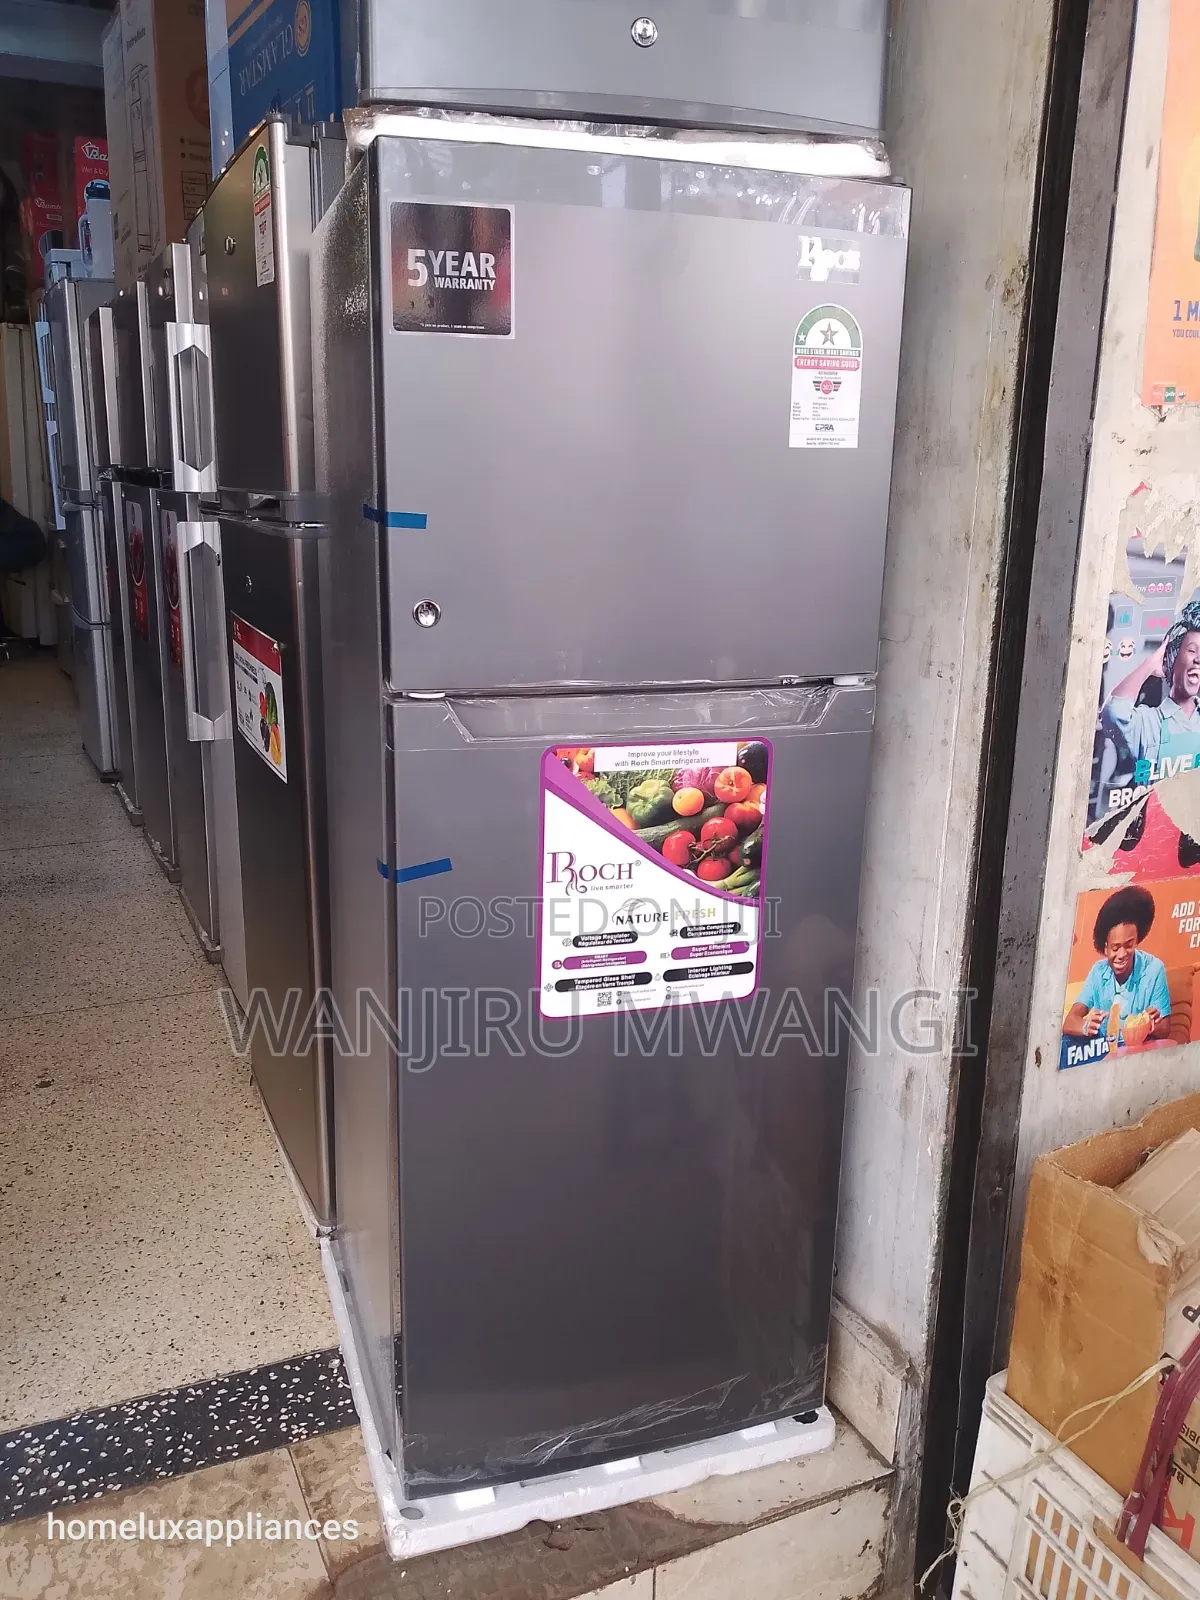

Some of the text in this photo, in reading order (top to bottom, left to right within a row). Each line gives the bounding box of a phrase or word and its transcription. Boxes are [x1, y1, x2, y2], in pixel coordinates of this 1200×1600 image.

[239, 24, 294, 96] GLAMSTAR
[407, 249, 496, 287] 5 YEAR
[434, 277, 496, 290] WARRANTY
[1173, 300, 1200, 322] 1 M
[1172, 328, 1184, 338] YOU
[796, 358, 859, 369] ENERGY SAVING GUIDE
[628, 751, 655, 759] Improve
[673, 748, 699, 757] lifestyle
[605, 883, 633, 891] smarter
[615, 908, 716, 925] NATURE FRESH
[1171, 901, 1195, 918] ADD
[1179, 917, 1200, 934] FOR
[574, 977, 602, 985] Tempered
[1067, 1037, 1109, 1065] FANTA
